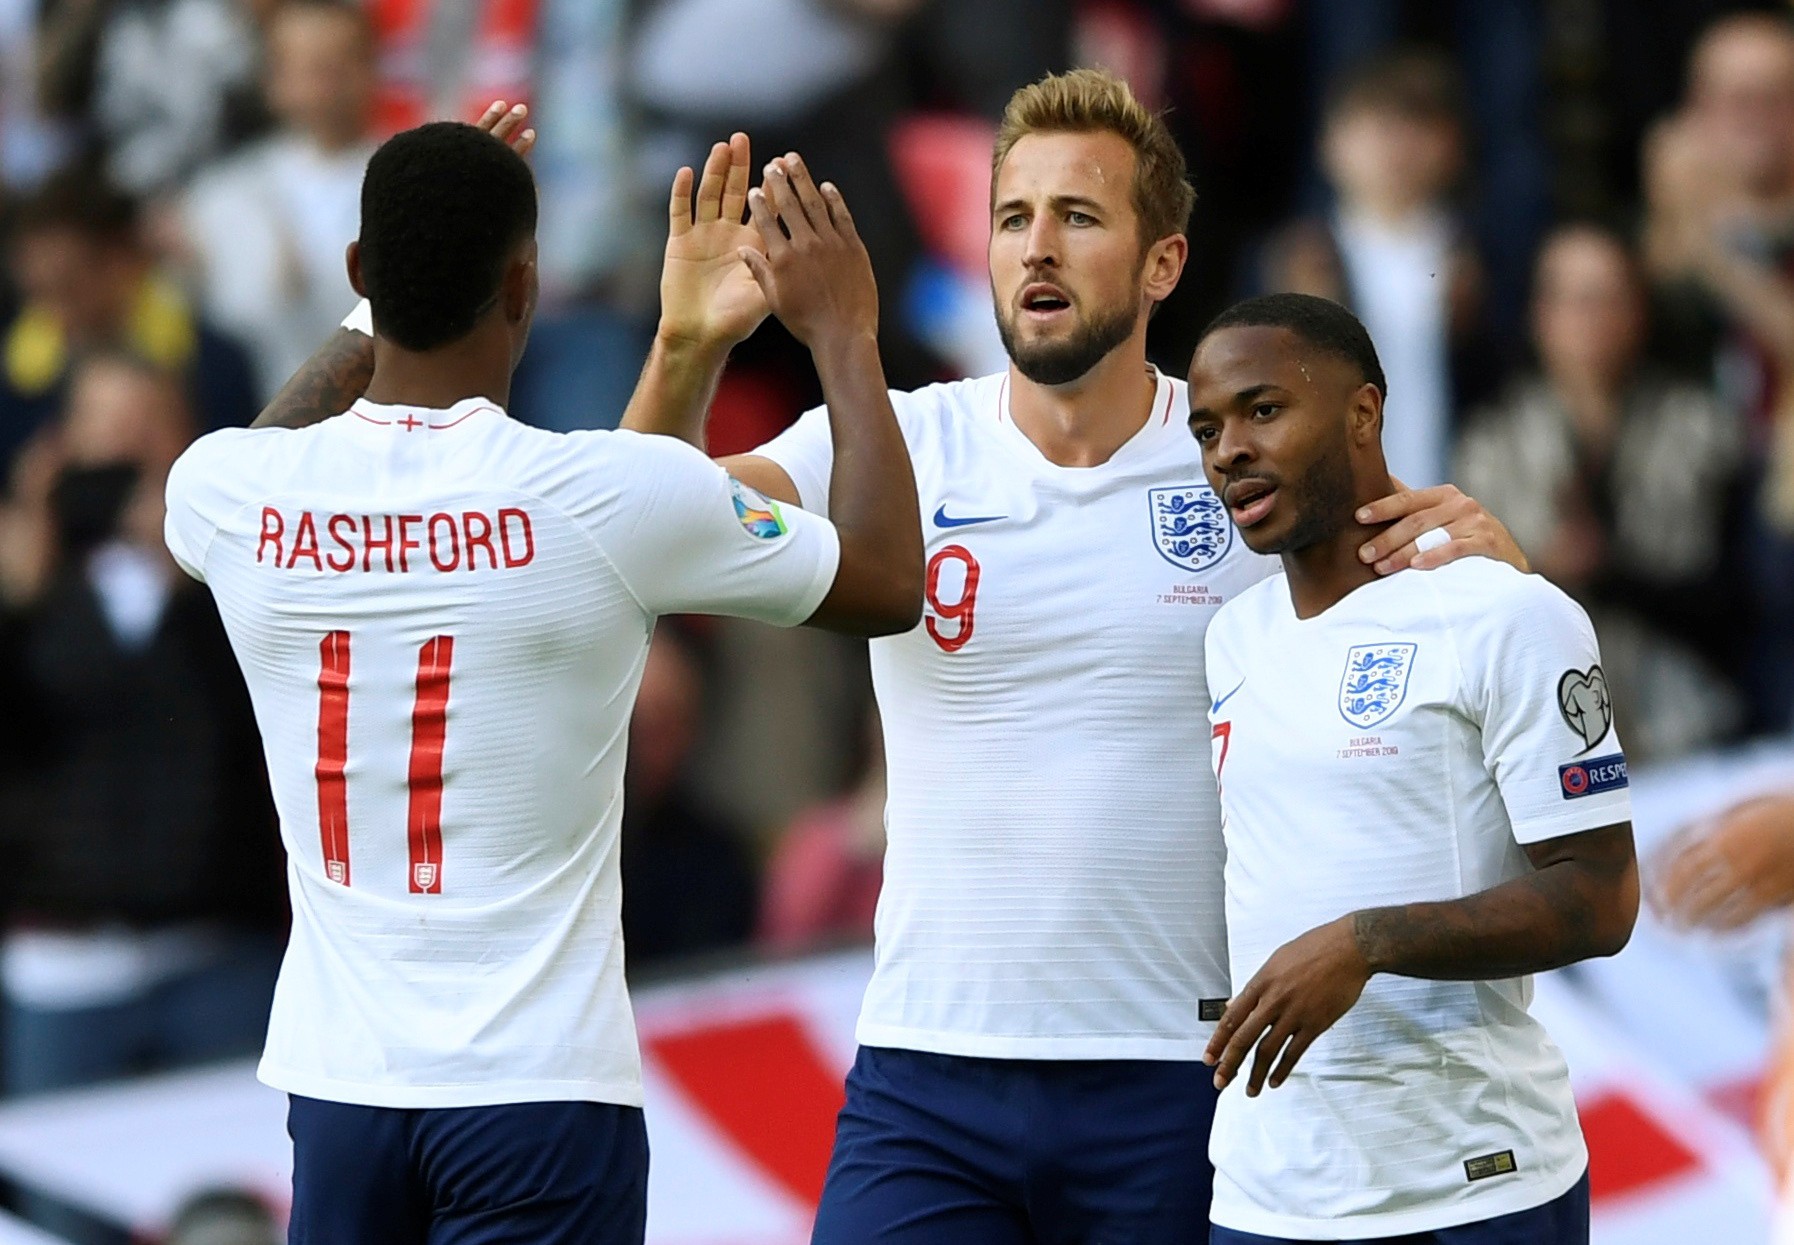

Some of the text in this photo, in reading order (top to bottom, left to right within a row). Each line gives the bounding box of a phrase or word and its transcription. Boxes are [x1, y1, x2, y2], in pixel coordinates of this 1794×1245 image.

[257, 506, 535, 573] RASHFORD
[925, 544, 980, 652] 9
[1163, 595, 1206, 604] SEPTEMBER
[1173, 585, 1209, 594] BULGARIA
[1350, 737, 1382, 747] BULGARIA
[315, 630, 455, 894] 11
